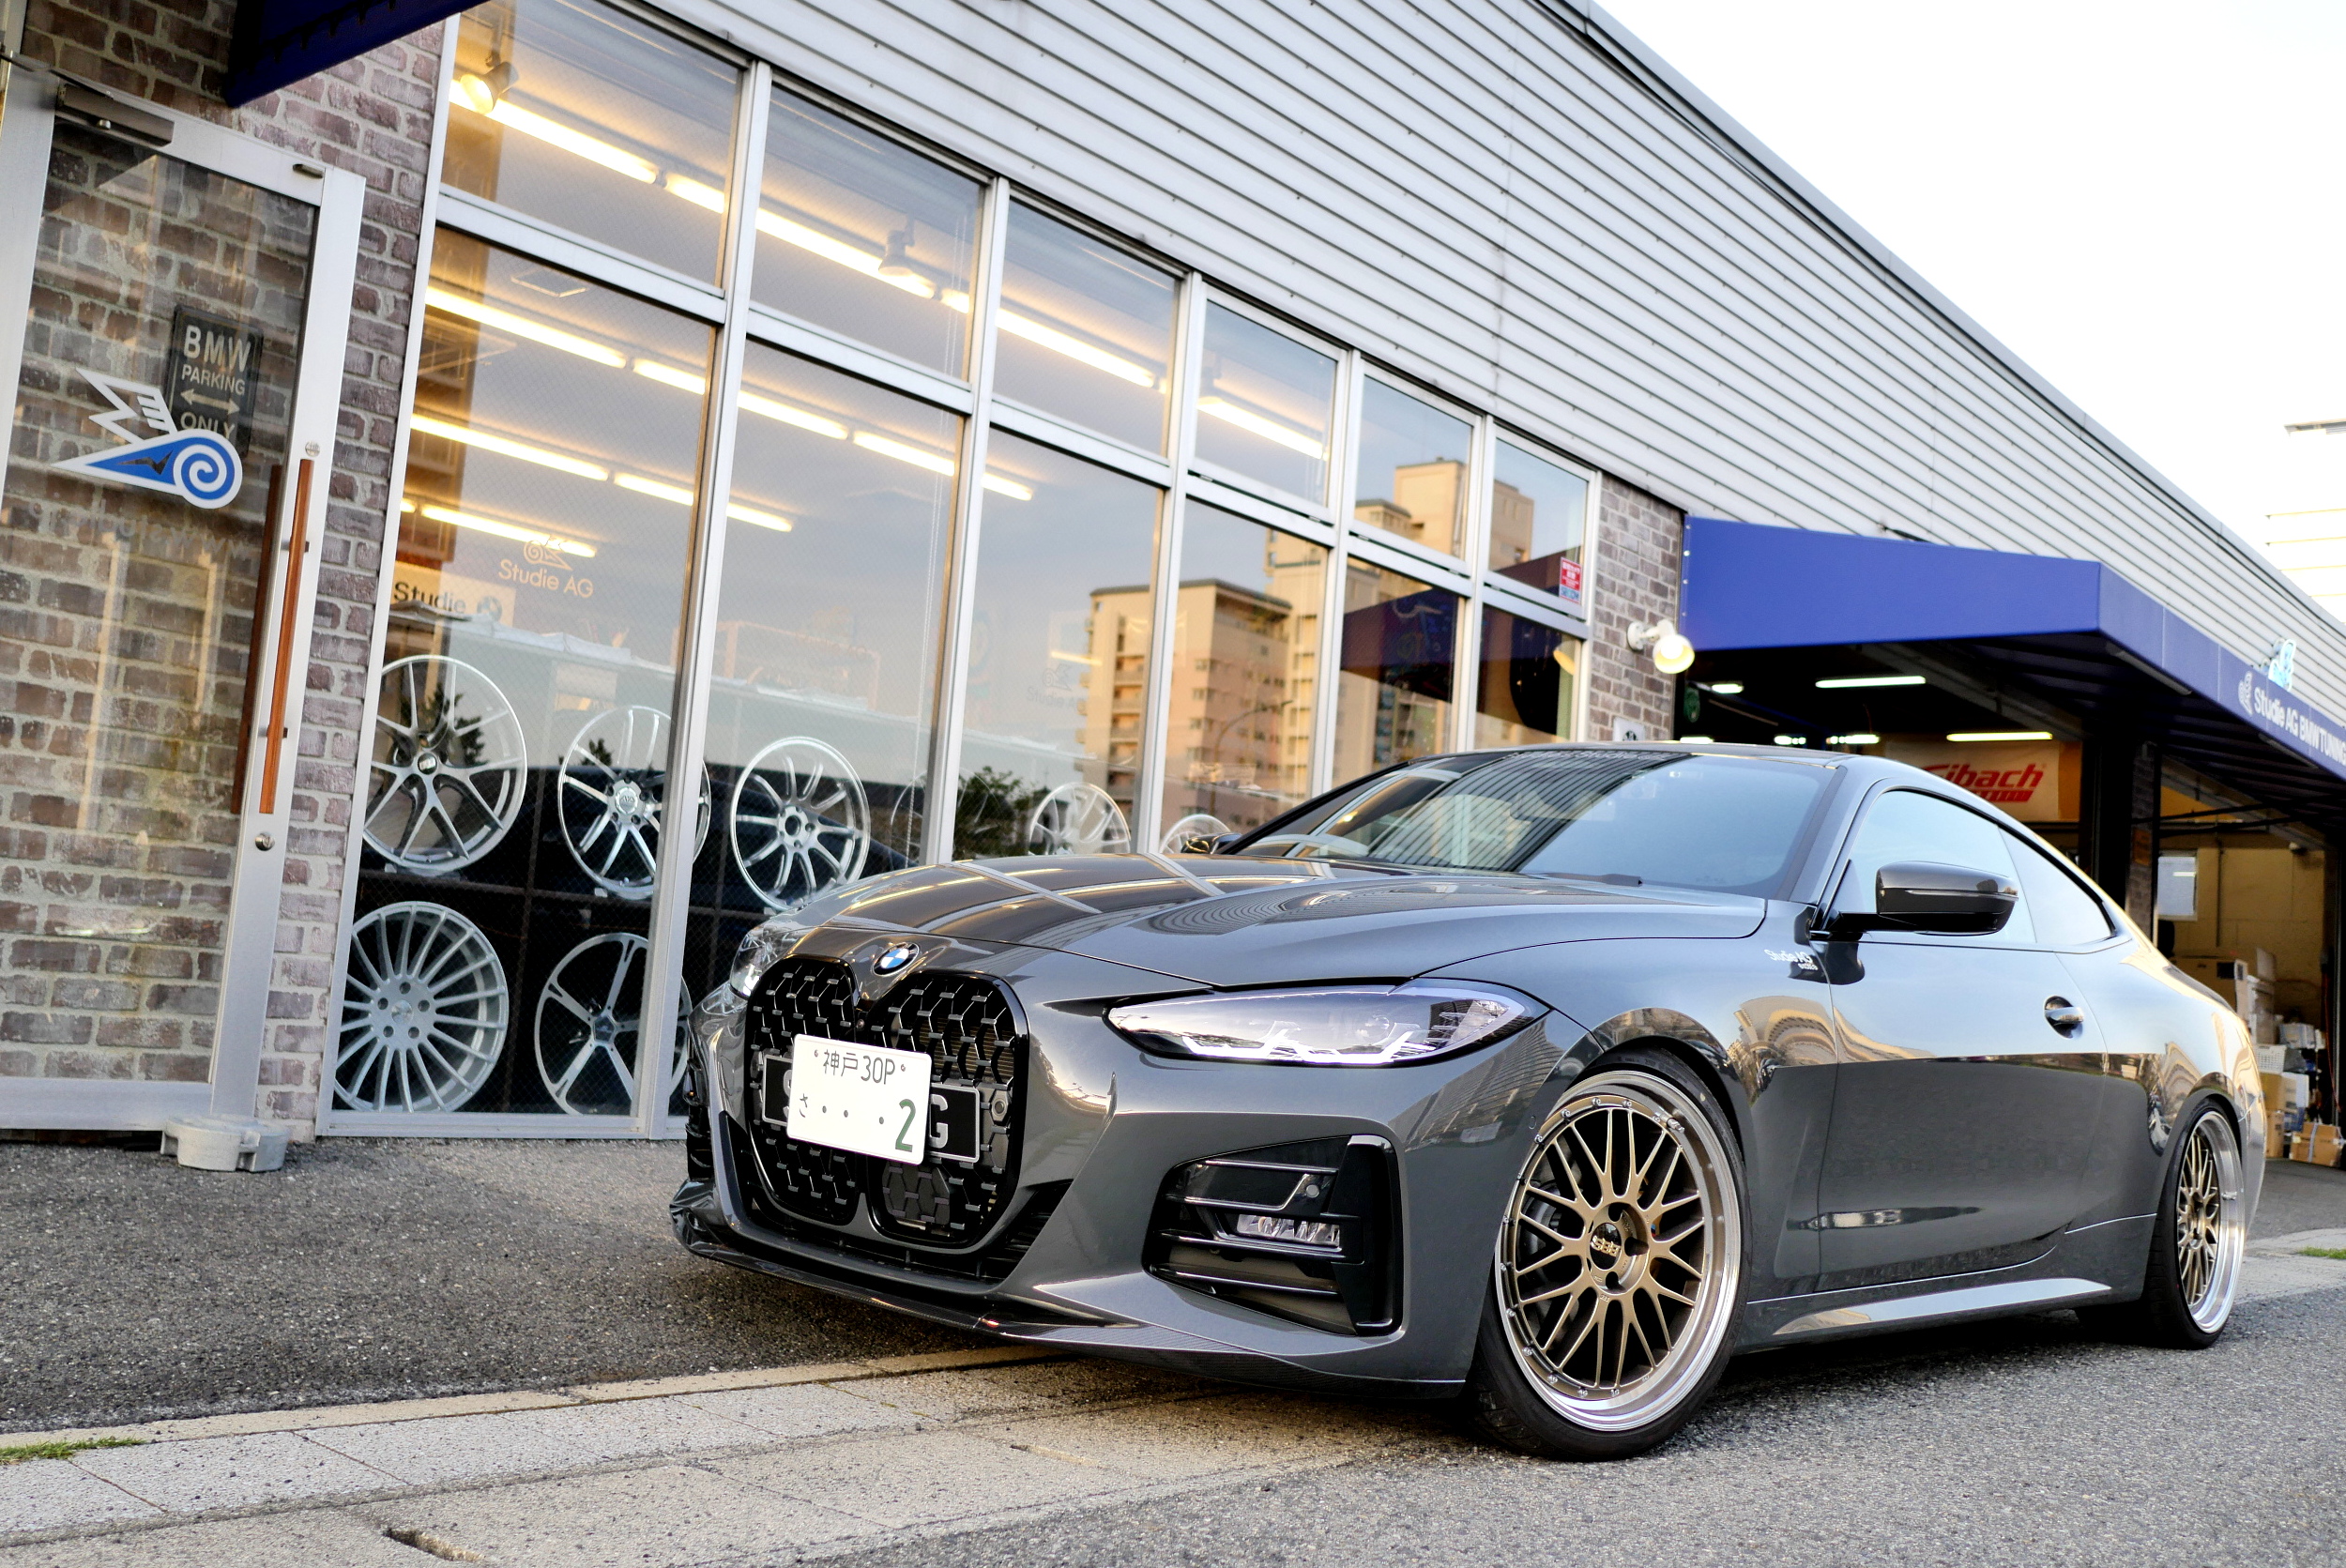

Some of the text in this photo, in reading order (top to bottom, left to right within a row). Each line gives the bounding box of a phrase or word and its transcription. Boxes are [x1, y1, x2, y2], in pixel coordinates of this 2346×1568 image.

[183, 325, 251, 373] BMW
[181, 363, 245, 395] PARKING
[180, 411, 236, 439] ONLY
[498, 558, 594, 599] Studie AG
[393, 581, 467, 615] Studie
[2254, 686, 2285, 728] Studie
[2285, 707, 2299, 738] AG
[2299, 714, 2320, 750] BMW
[799, 1092, 809, 1119] さ
